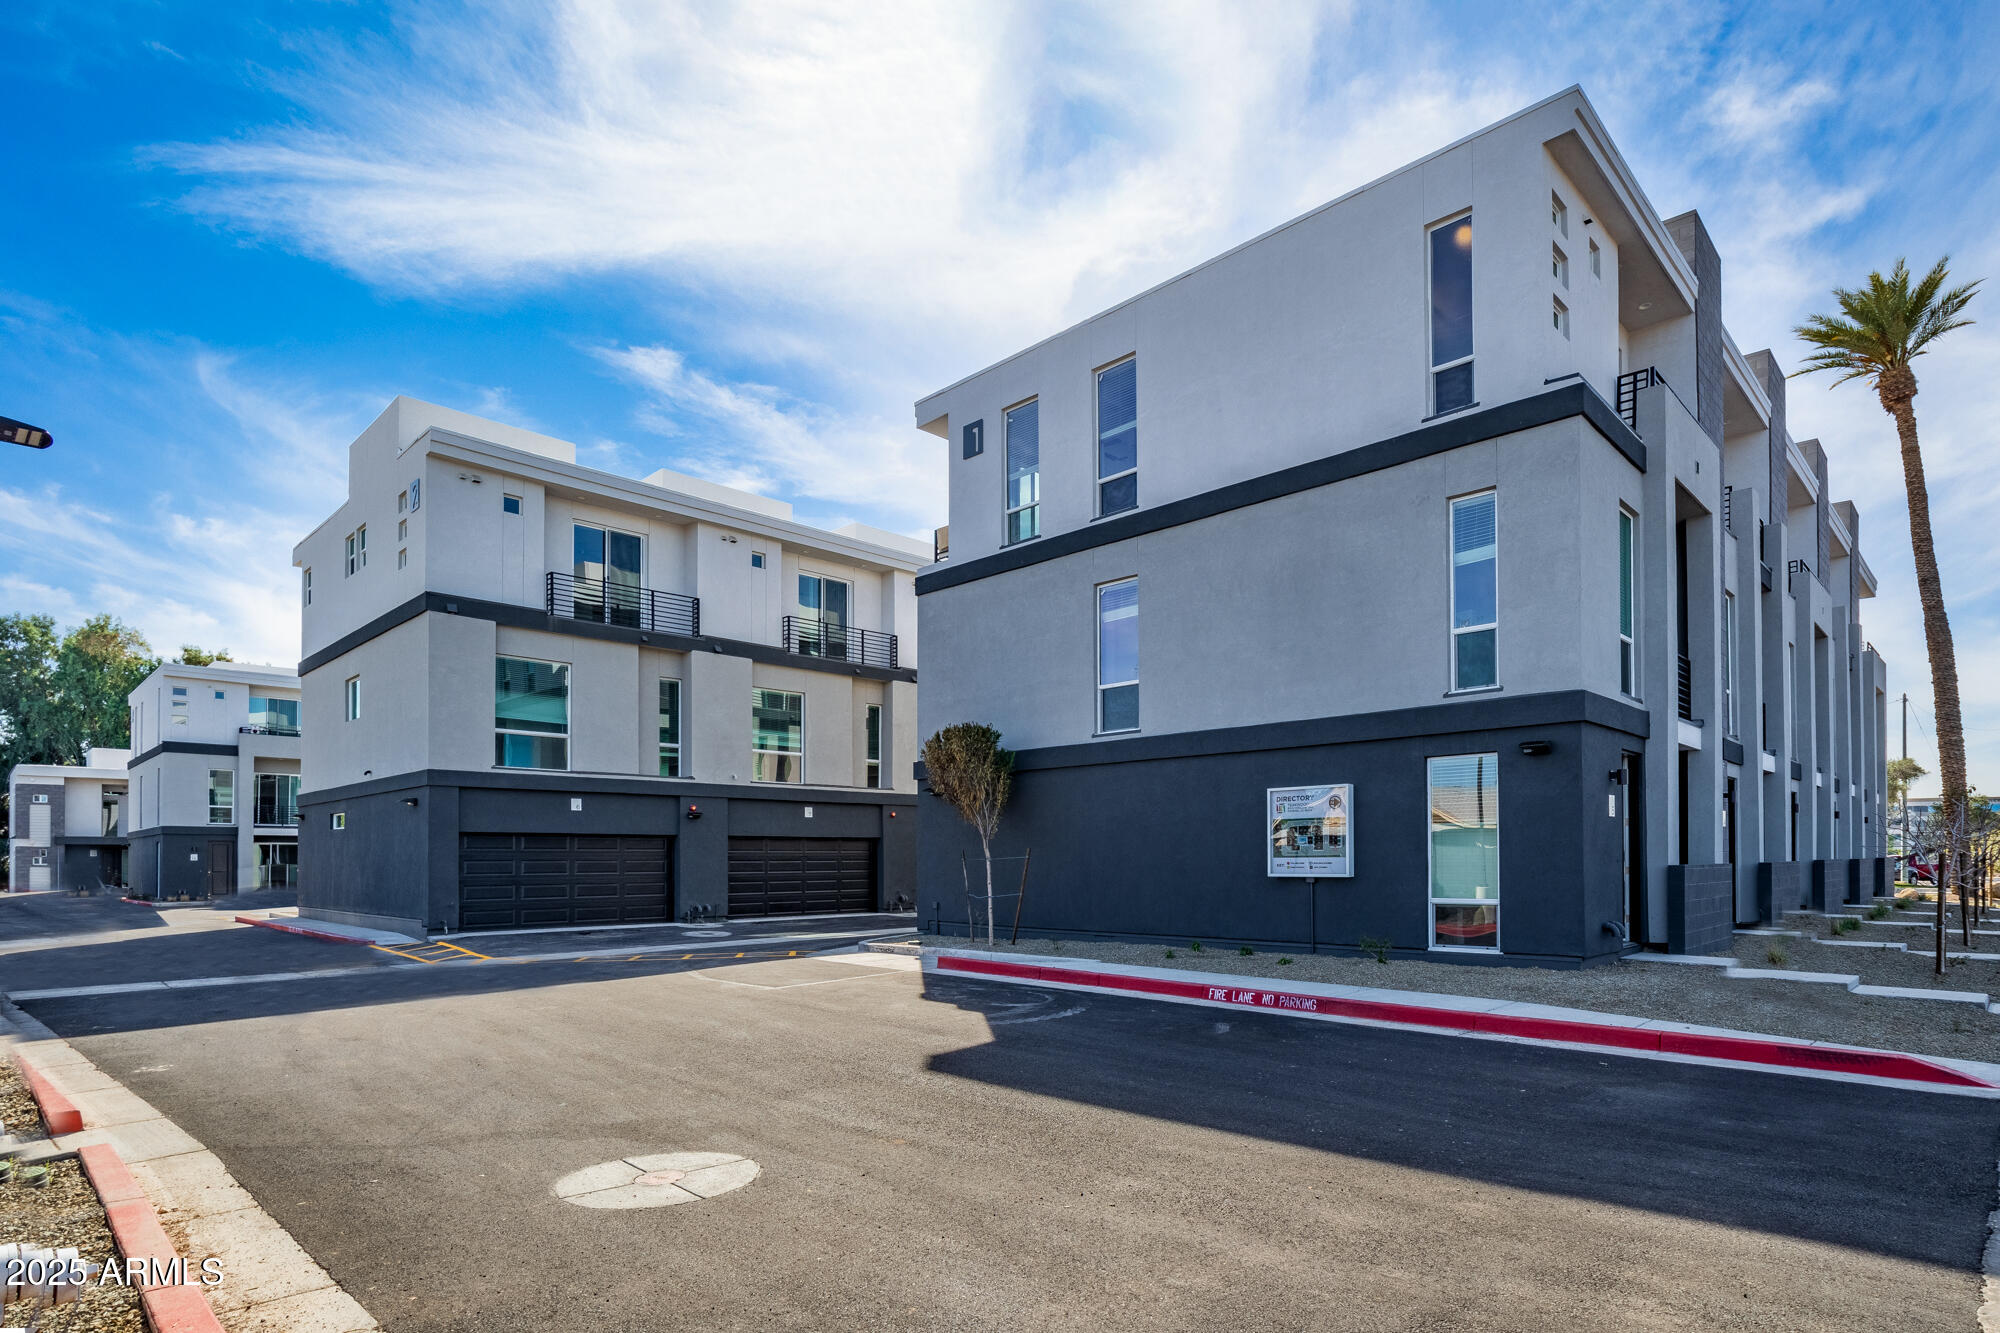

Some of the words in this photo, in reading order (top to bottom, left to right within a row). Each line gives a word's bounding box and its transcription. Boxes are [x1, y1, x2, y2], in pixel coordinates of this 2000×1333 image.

[972, 427, 979, 452] 1
[1276, 794, 1315, 803] DIRECTORY
[1208, 988, 1228, 1001] FIRE
[1232, 990, 1256, 1004] LANE
[1261, 993, 1275, 1006] NO
[1279, 995, 1317, 1011] PARKING
